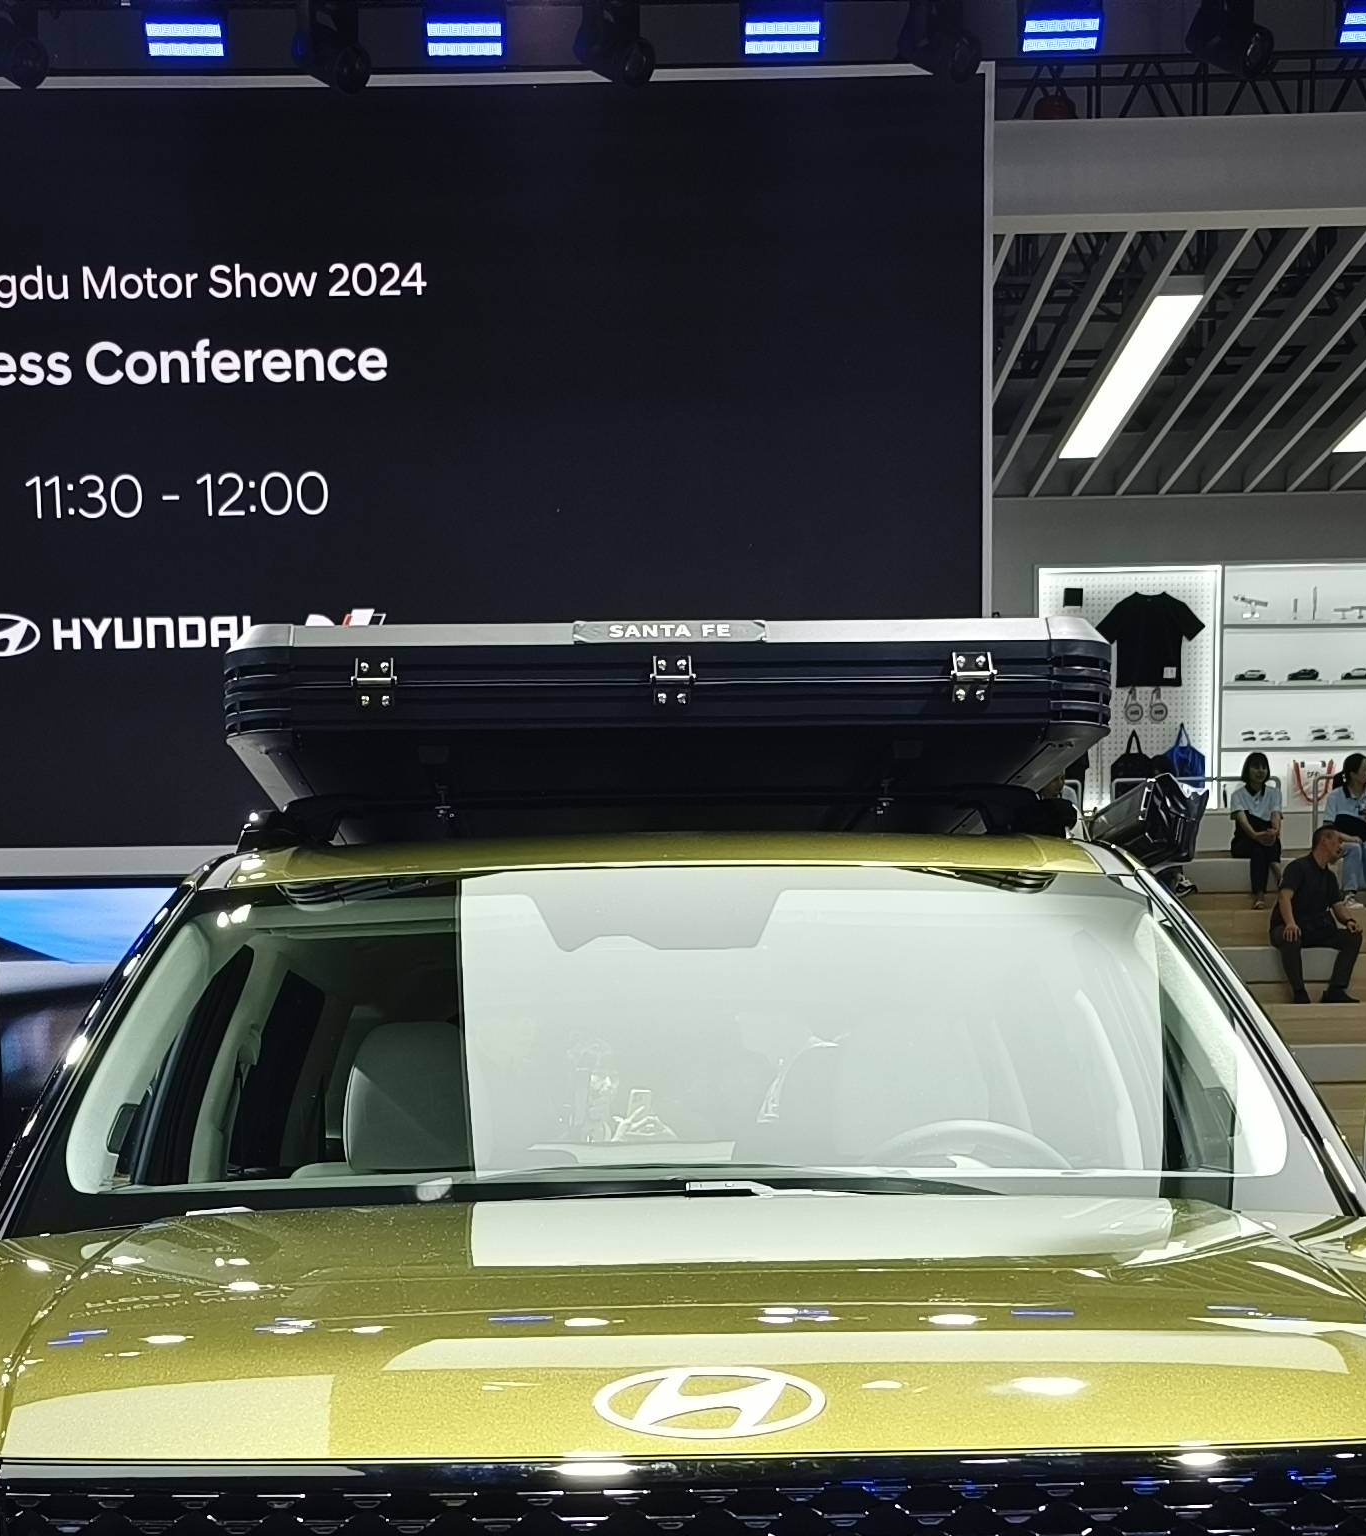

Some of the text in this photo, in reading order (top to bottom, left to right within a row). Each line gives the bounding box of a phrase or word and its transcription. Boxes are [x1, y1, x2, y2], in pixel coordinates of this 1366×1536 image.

[82, 265, 199, 300] Motor
[208, 263, 319, 299] Show
[328, 261, 428, 297] 2024
[85, 338, 389, 386] Conference
[25, 473, 143, 520] 11:30
[196, 470, 329, 517] 12:00
[609, 623, 731, 638] SANTA FE
